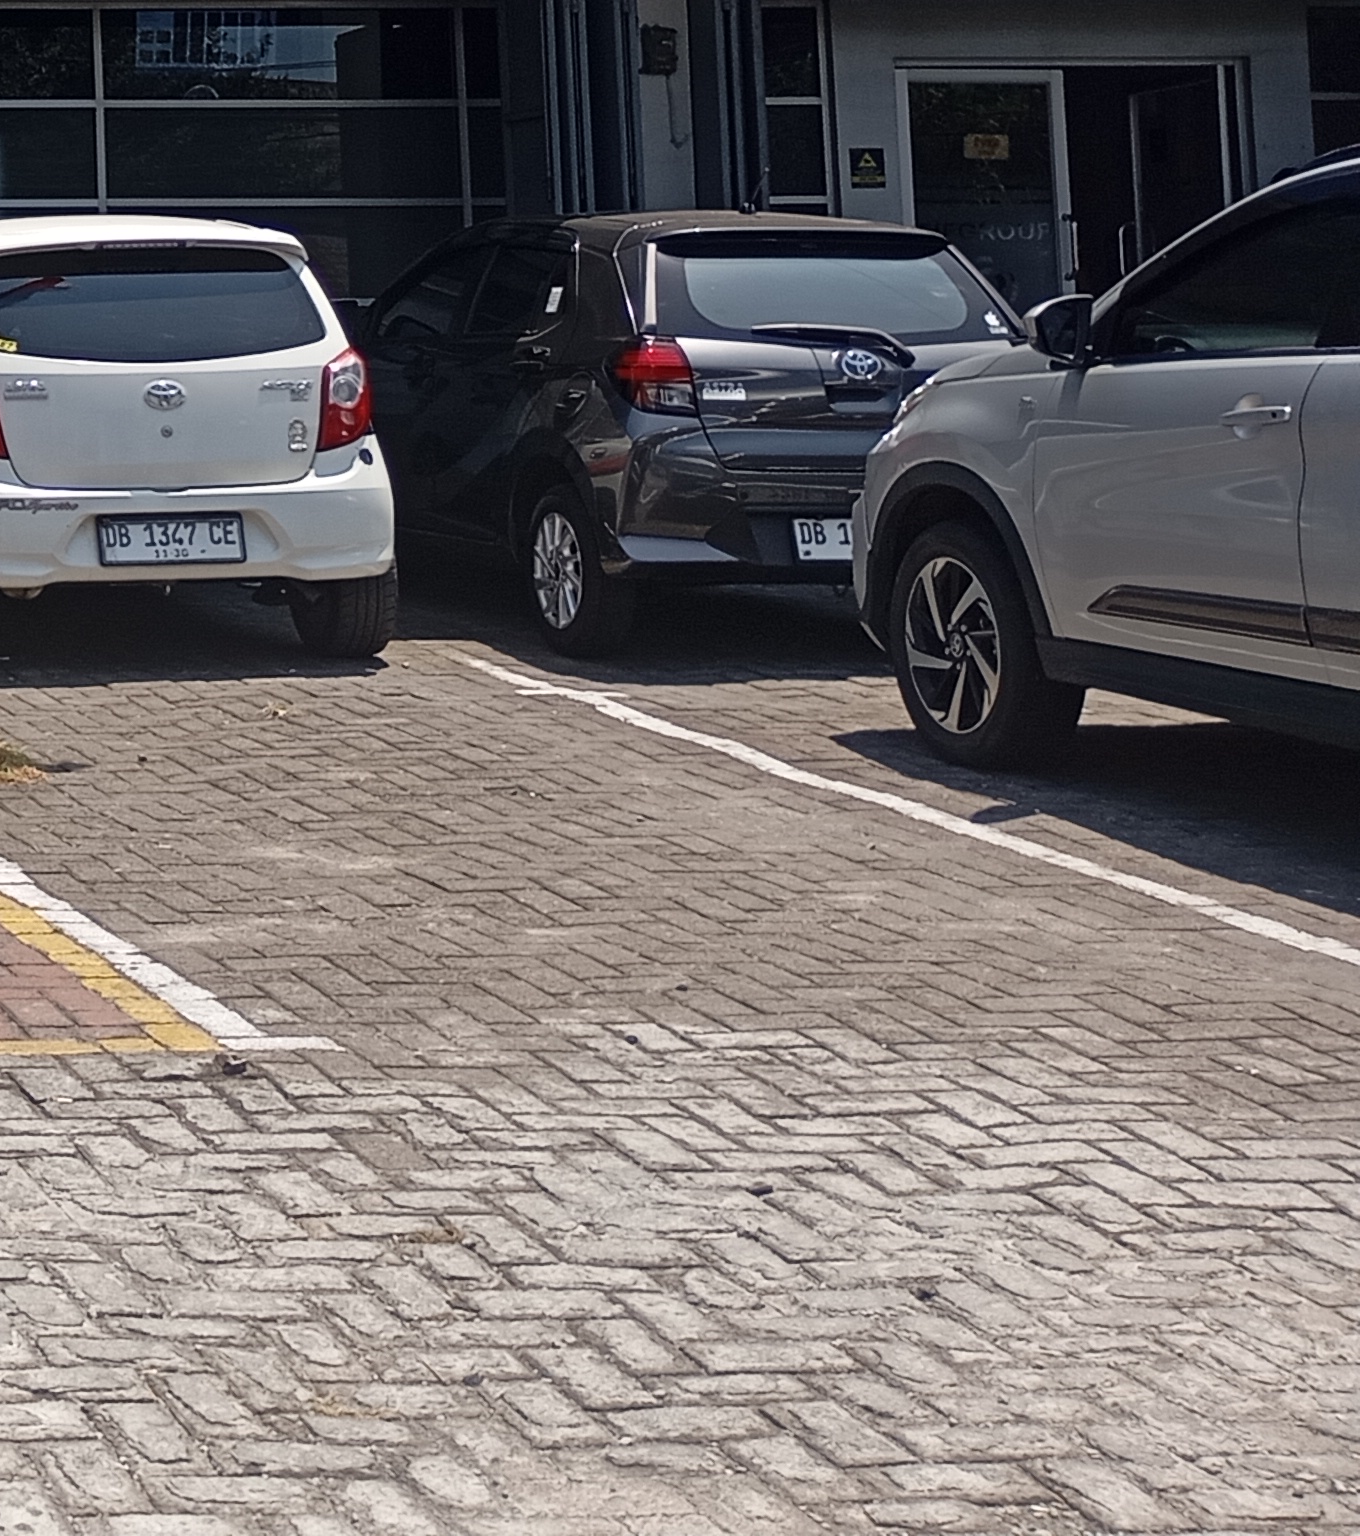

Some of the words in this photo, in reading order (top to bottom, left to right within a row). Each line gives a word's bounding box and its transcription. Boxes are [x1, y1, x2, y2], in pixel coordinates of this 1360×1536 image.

[102, 523, 132, 548] DB
[143, 522, 197, 547] 1347
[208, 521, 237, 545] CE
[797, 522, 827, 545] DB
